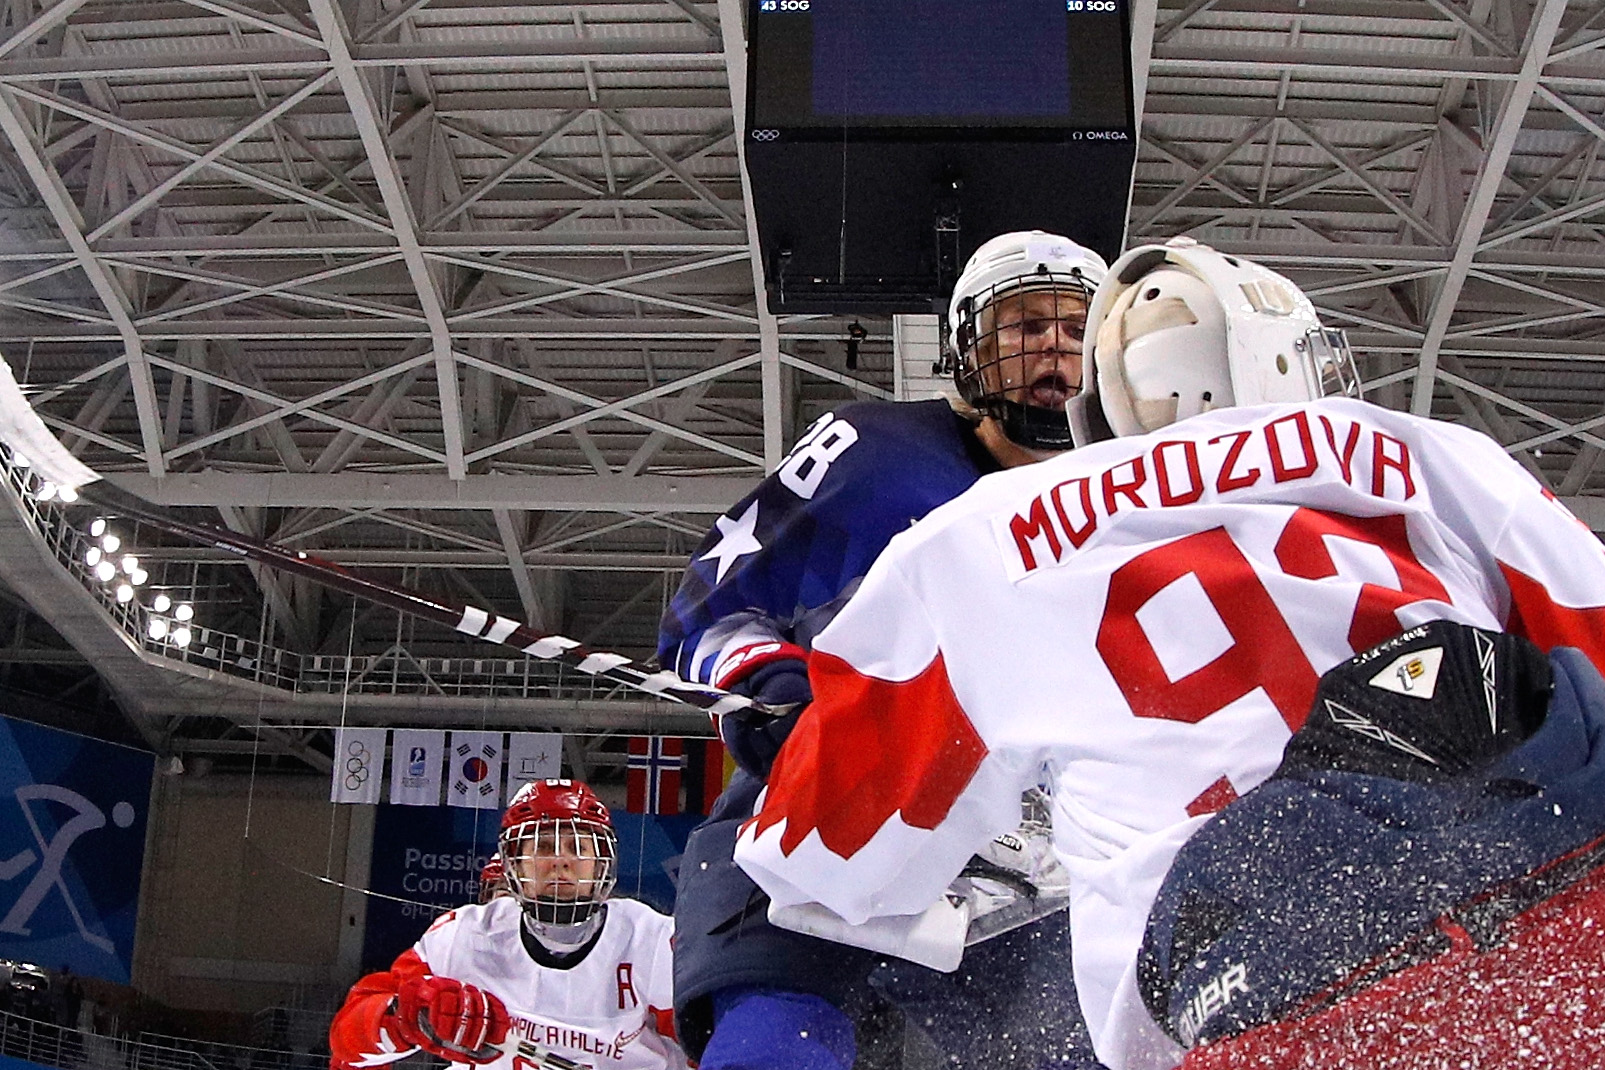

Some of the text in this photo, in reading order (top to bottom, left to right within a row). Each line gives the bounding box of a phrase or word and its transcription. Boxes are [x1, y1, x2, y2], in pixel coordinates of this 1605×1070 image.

[780, 1, 810, 11] SOG
[1067, 1, 1116, 12] 10 SOG
[1086, 131, 1128, 140] OMEGA
[1009, 410, 1416, 572] MOROZOVA
[1095, 505, 1455, 816] 92
[405, 848, 488, 871] Passio
[403, 873, 478, 895] Conne
[616, 962, 639, 1010] A
[1179, 962, 1249, 1047] AUER
